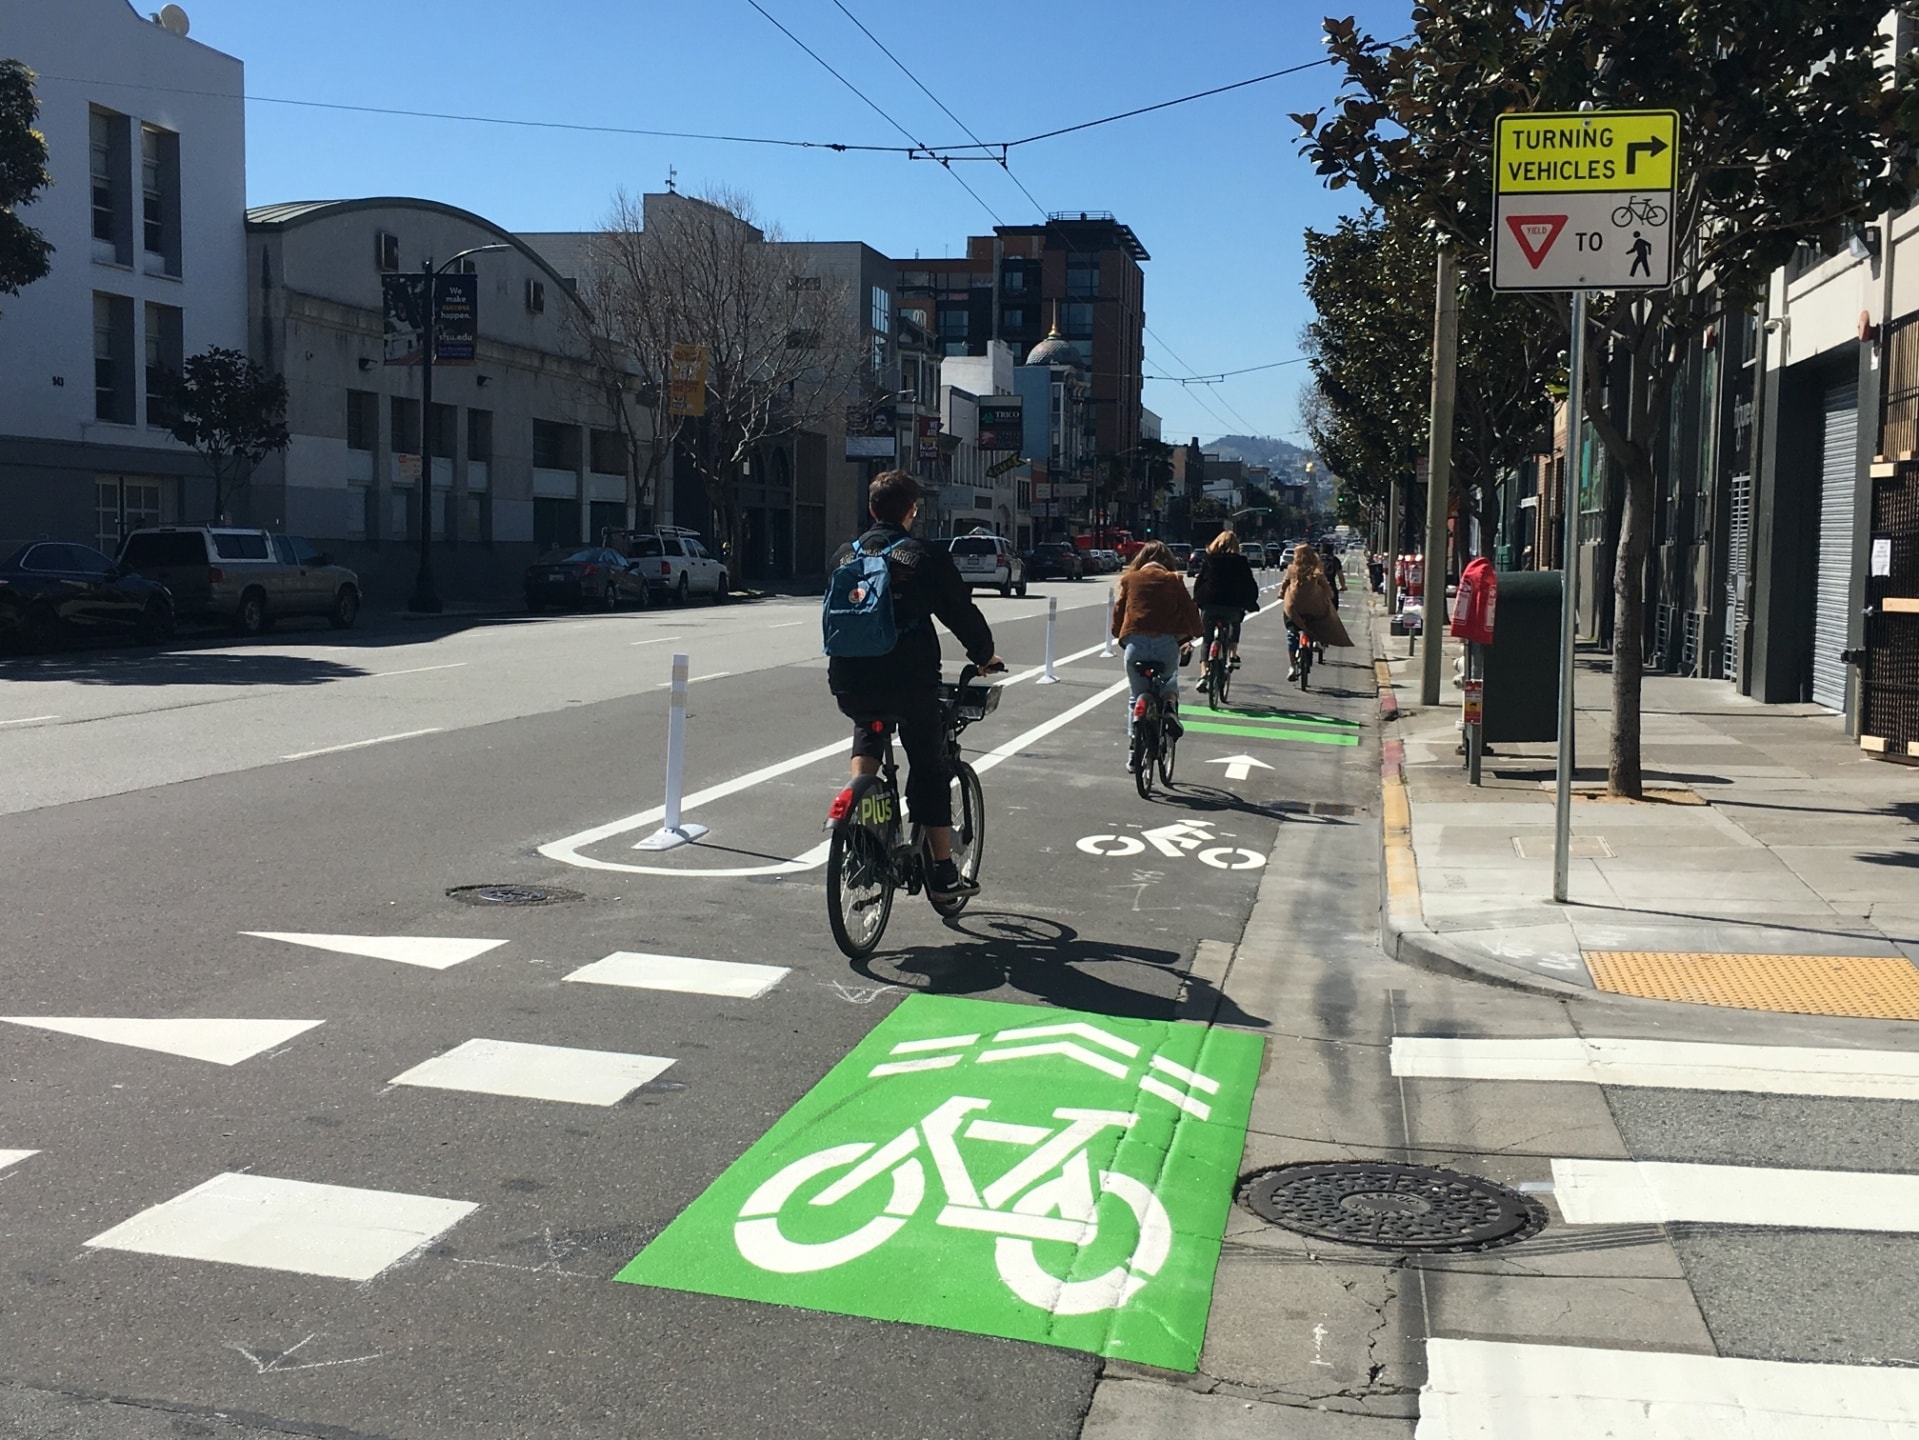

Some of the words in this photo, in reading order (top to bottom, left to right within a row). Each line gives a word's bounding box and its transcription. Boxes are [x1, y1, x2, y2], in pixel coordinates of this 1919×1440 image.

[1512, 128, 1614, 149] TURNING
[1508, 160, 1616, 181] VEHICLES
[1526, 223, 1548, 235] YIELD
[1575, 232, 1603, 252] TO
[440, 311, 471, 320] happen.
[439, 333, 472, 341] sfsu.edu
[53, 376, 64, 387] 943
